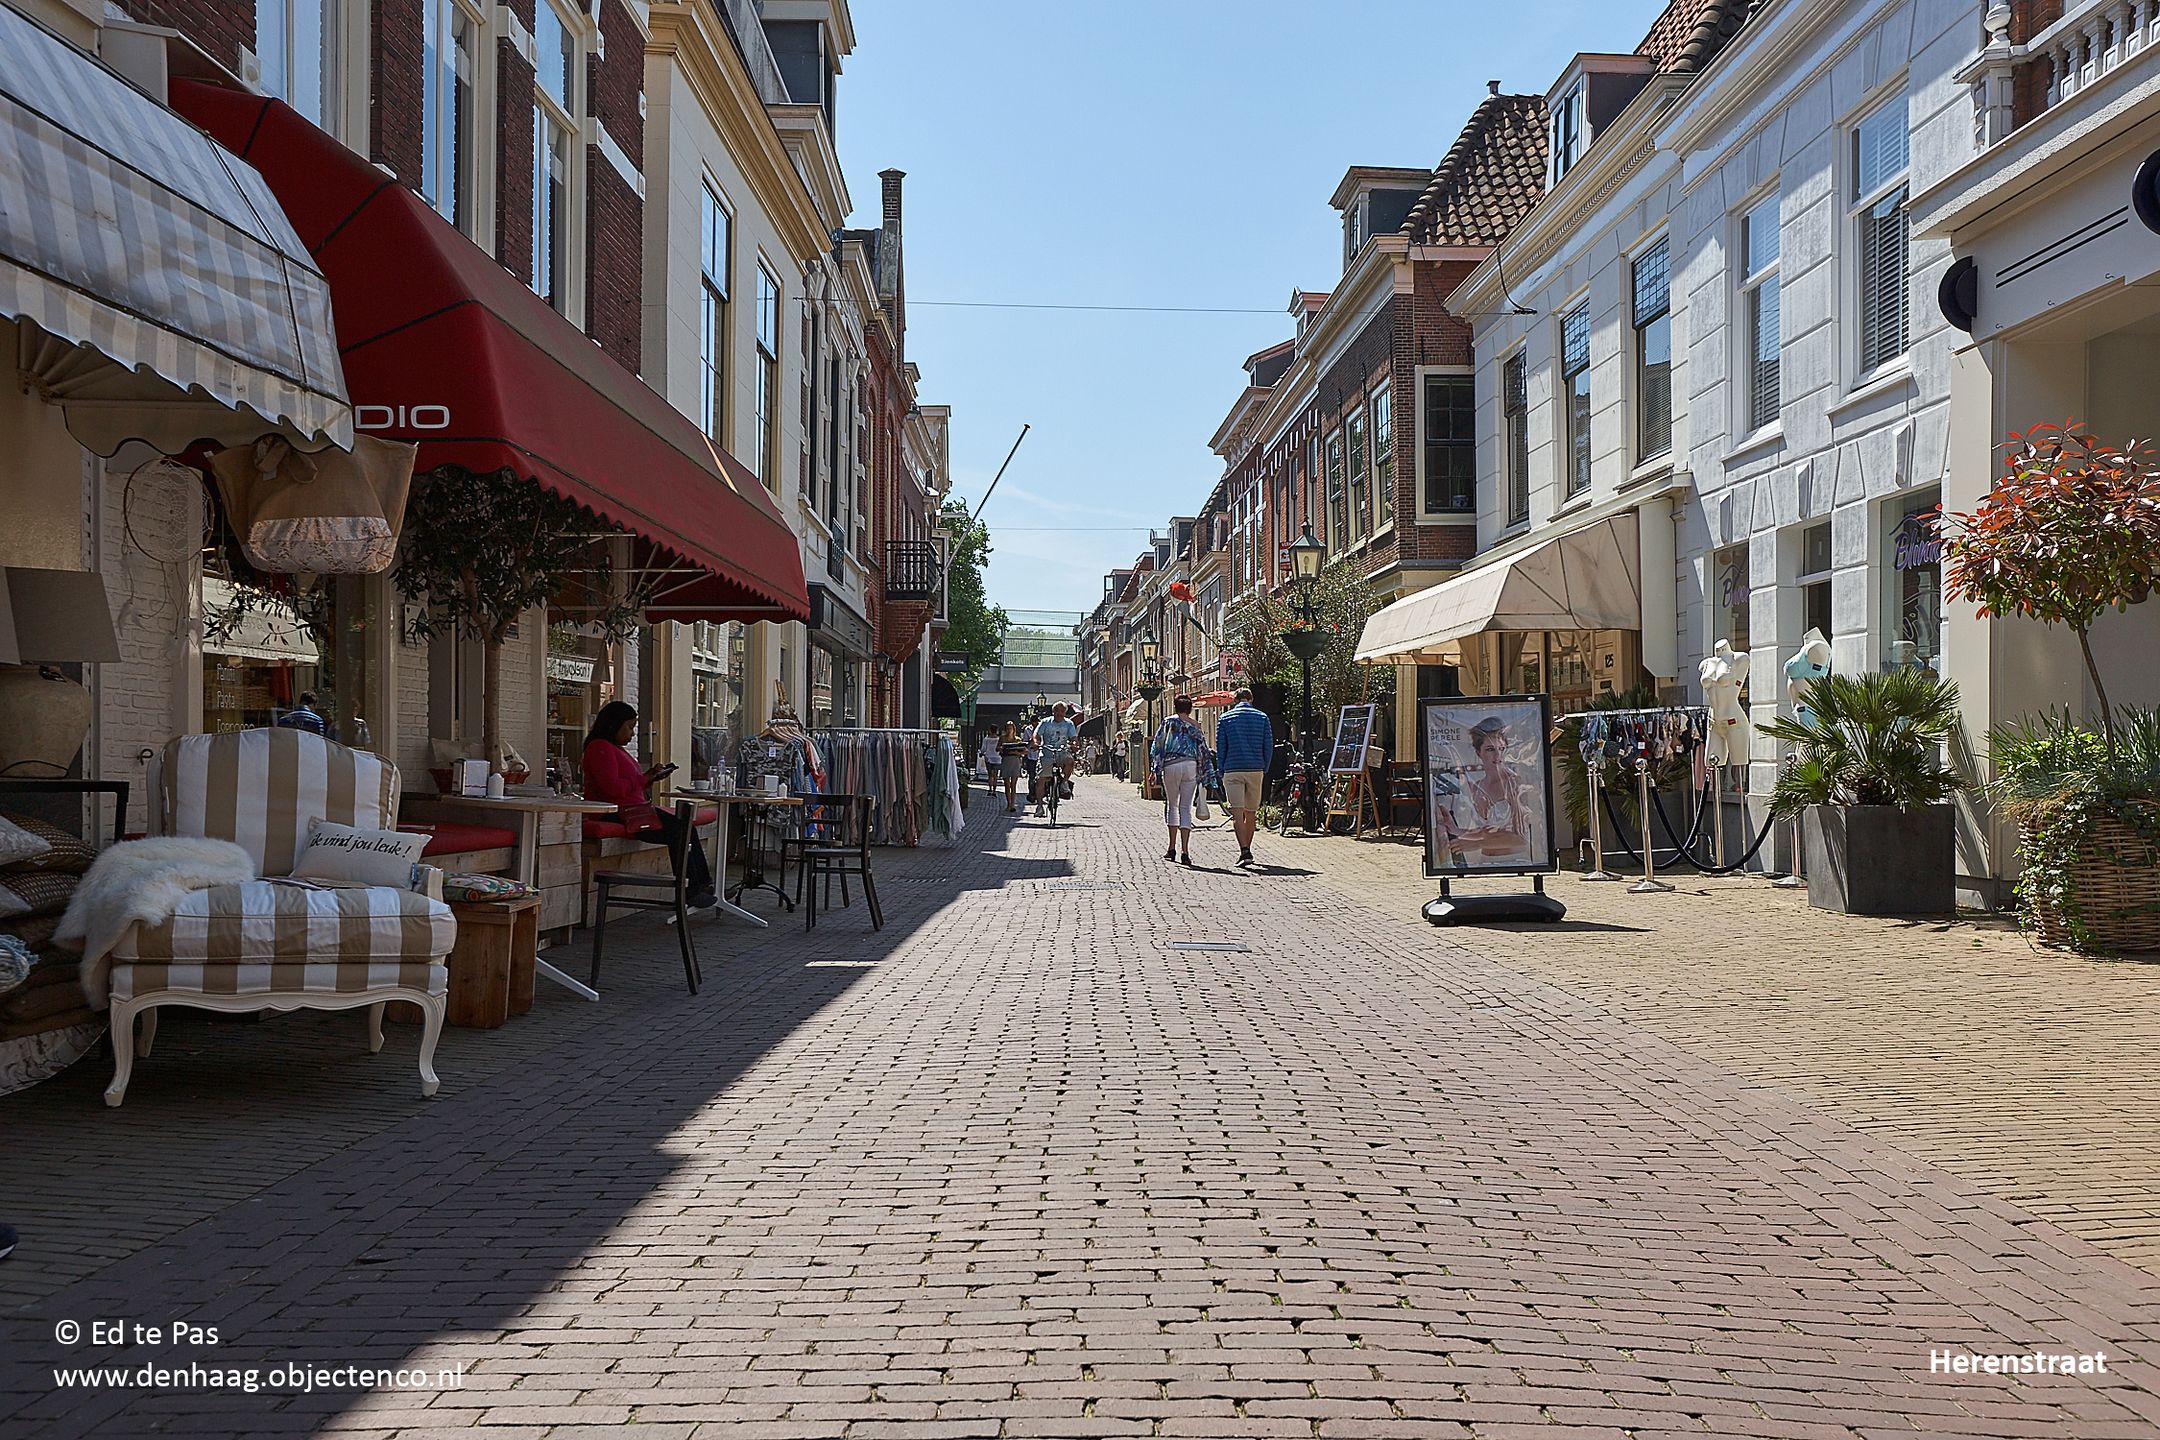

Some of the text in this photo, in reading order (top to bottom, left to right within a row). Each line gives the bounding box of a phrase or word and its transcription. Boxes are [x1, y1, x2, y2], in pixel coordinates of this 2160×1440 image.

[310, 833, 323, 848] ik
[324, 833, 353, 847] vind
[346, 836, 373, 853] jou
